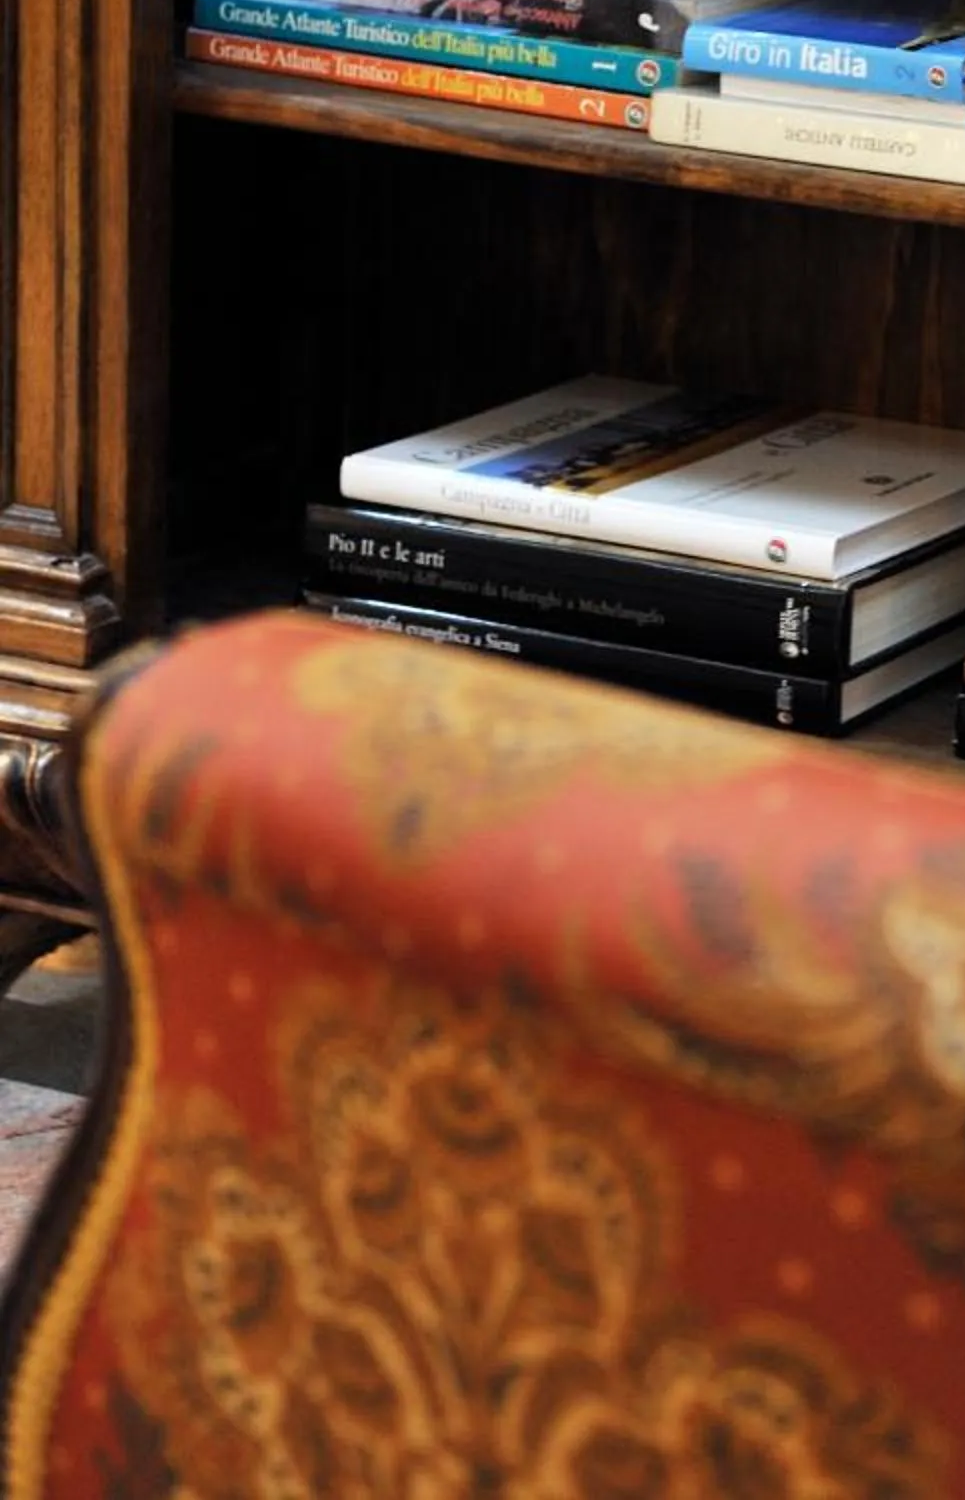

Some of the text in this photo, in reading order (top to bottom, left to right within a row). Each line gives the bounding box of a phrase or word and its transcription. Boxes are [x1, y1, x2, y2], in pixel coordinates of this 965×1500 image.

[219, 3, 279, 30] Grande
[281, 11, 341, 38] Atlante
[344, 18, 410, 48] Turistico
[411, 23, 485, 58] dell'Italia
[486, 37, 516, 68] più
[518, 45, 558, 69] bella
[707, 30, 761, 63] Giro
[768, 40, 791, 68] in
[799, 42, 868, 80] Italia
[209, 37, 607, 117] Grande Atlante Turistico dell'Italia più bella 2
[328, 532, 446, 569] Pio II e le arti
[486, 631, 521, 654] Siena
